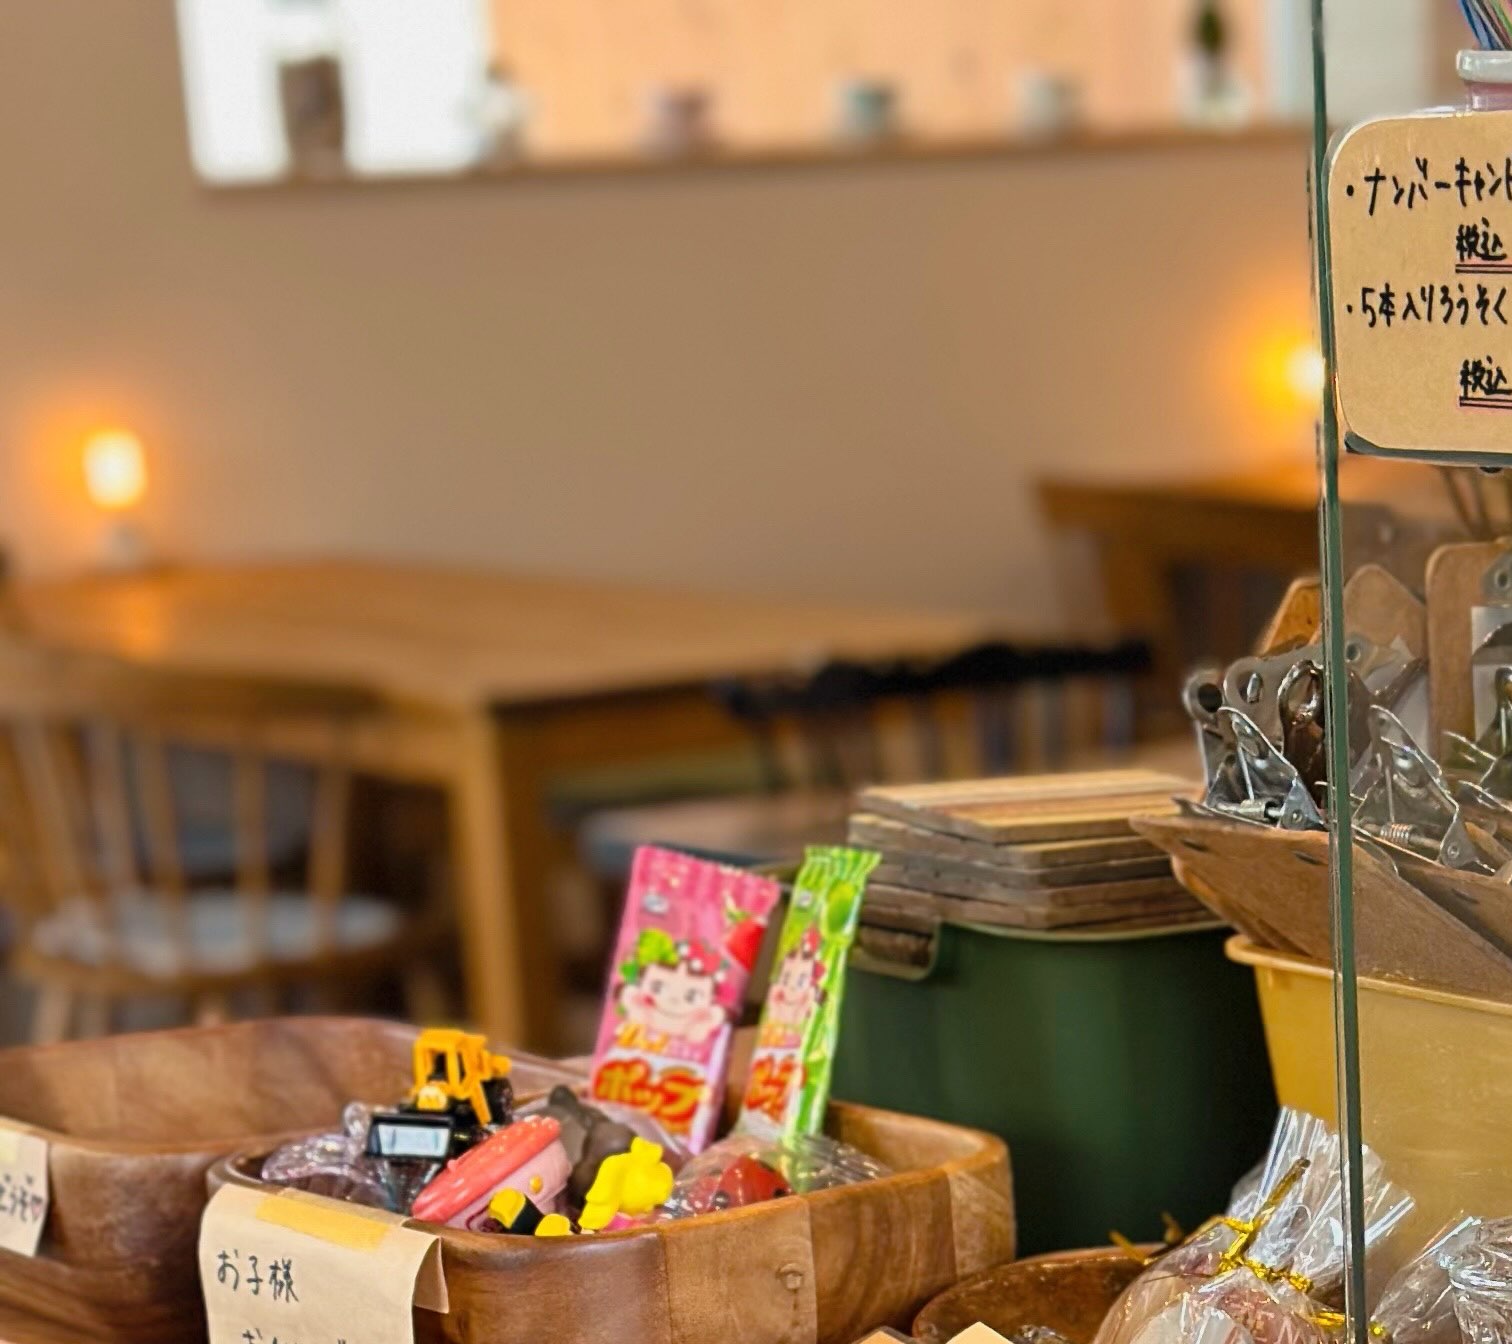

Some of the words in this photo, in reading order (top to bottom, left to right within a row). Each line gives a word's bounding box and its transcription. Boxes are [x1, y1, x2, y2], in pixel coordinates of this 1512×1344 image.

[1456, 217, 1507, 262] 税込
[1460, 355, 1512, 398] 税込
[217, 1249, 299, 1302] お子様
